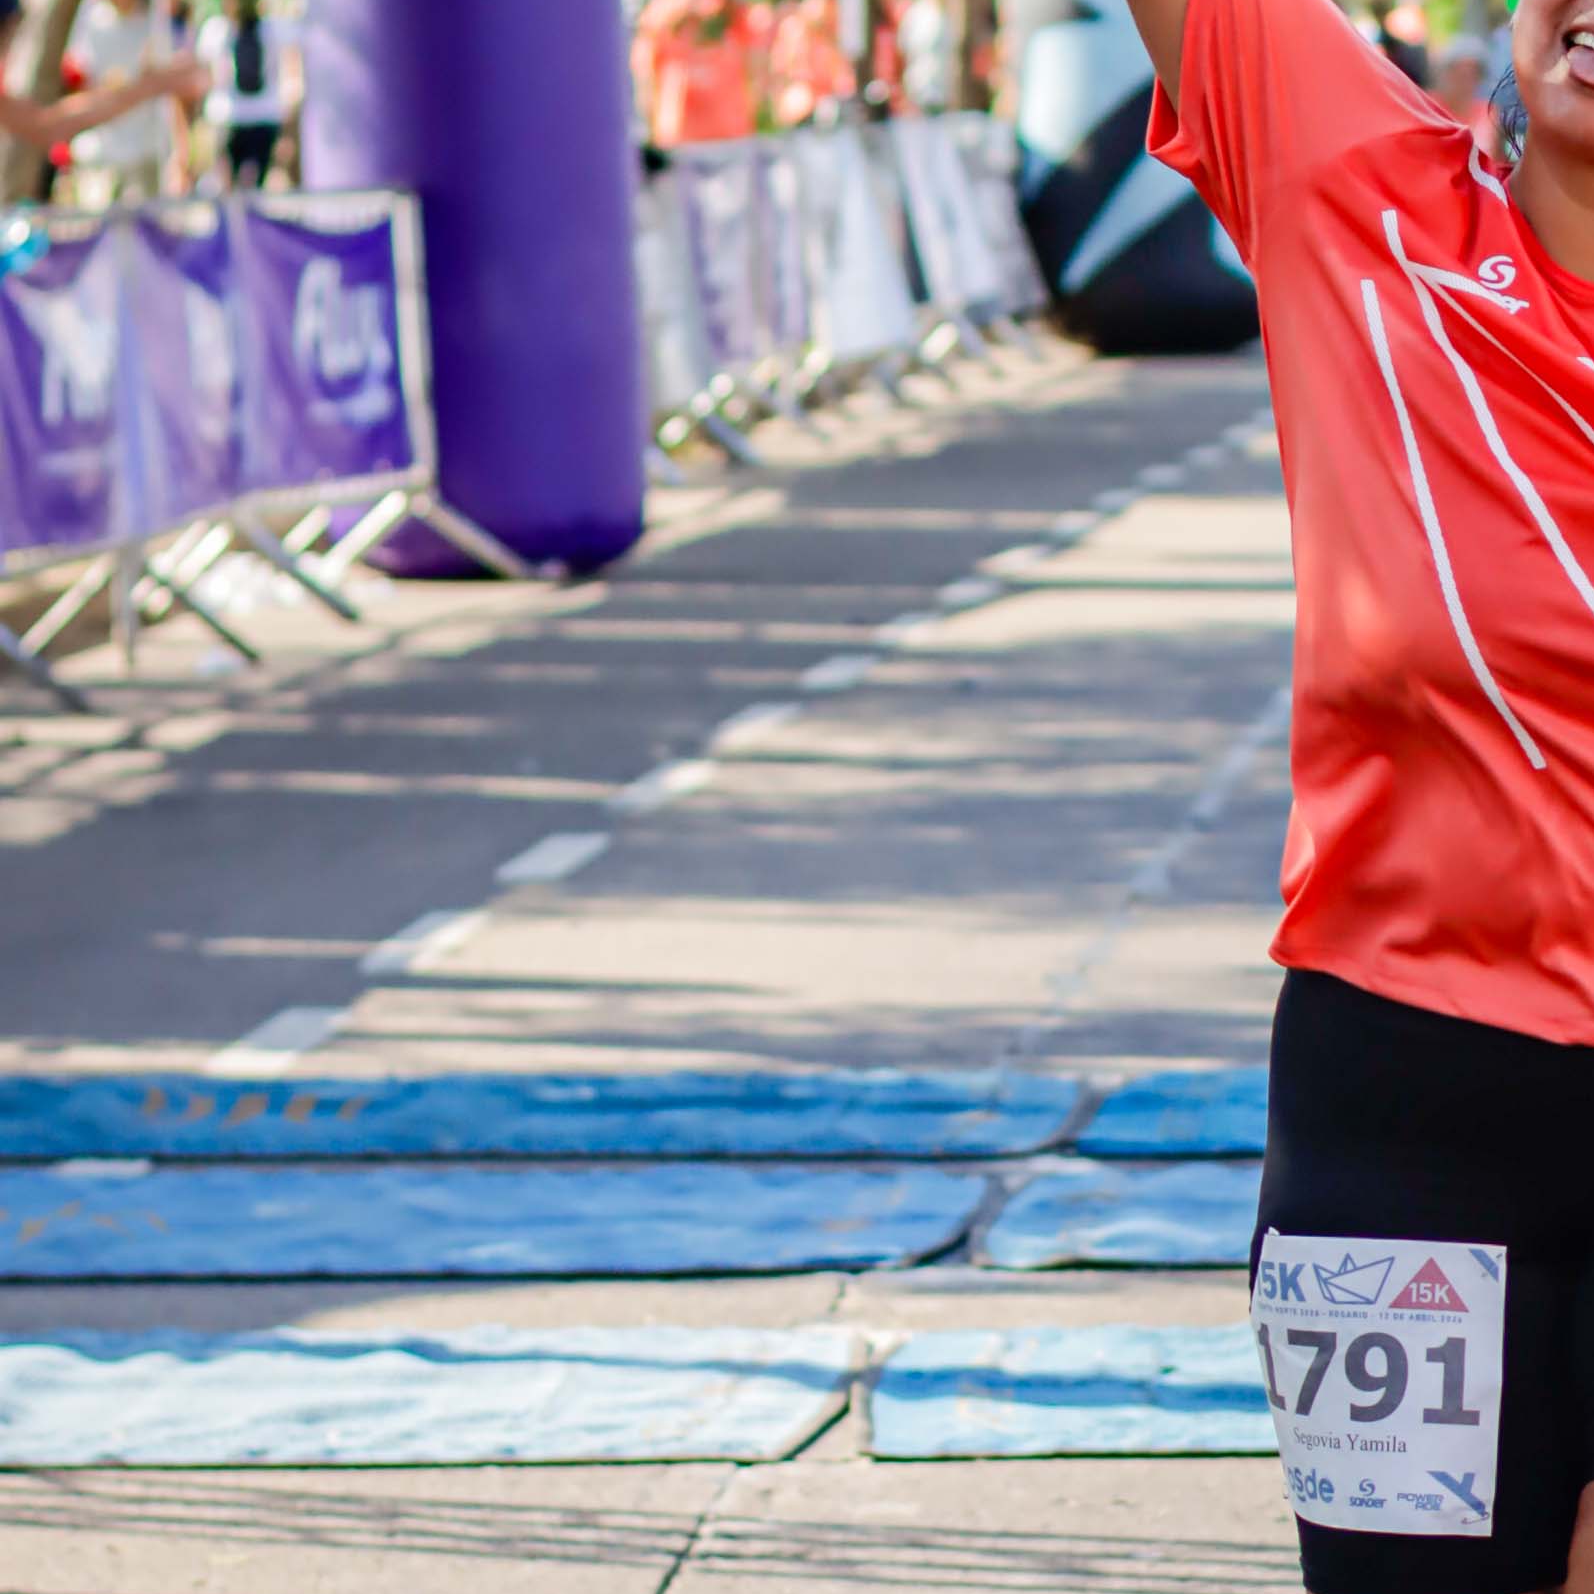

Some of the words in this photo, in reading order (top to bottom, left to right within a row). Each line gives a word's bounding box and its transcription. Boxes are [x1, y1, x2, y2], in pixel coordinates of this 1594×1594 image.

[1408, 1281, 1451, 1304] 15K
[1257, 1323, 1480, 1426] 1791
[1293, 1426, 1342, 1451] Segovia
[1346, 1433, 1407, 1454] Yamila
